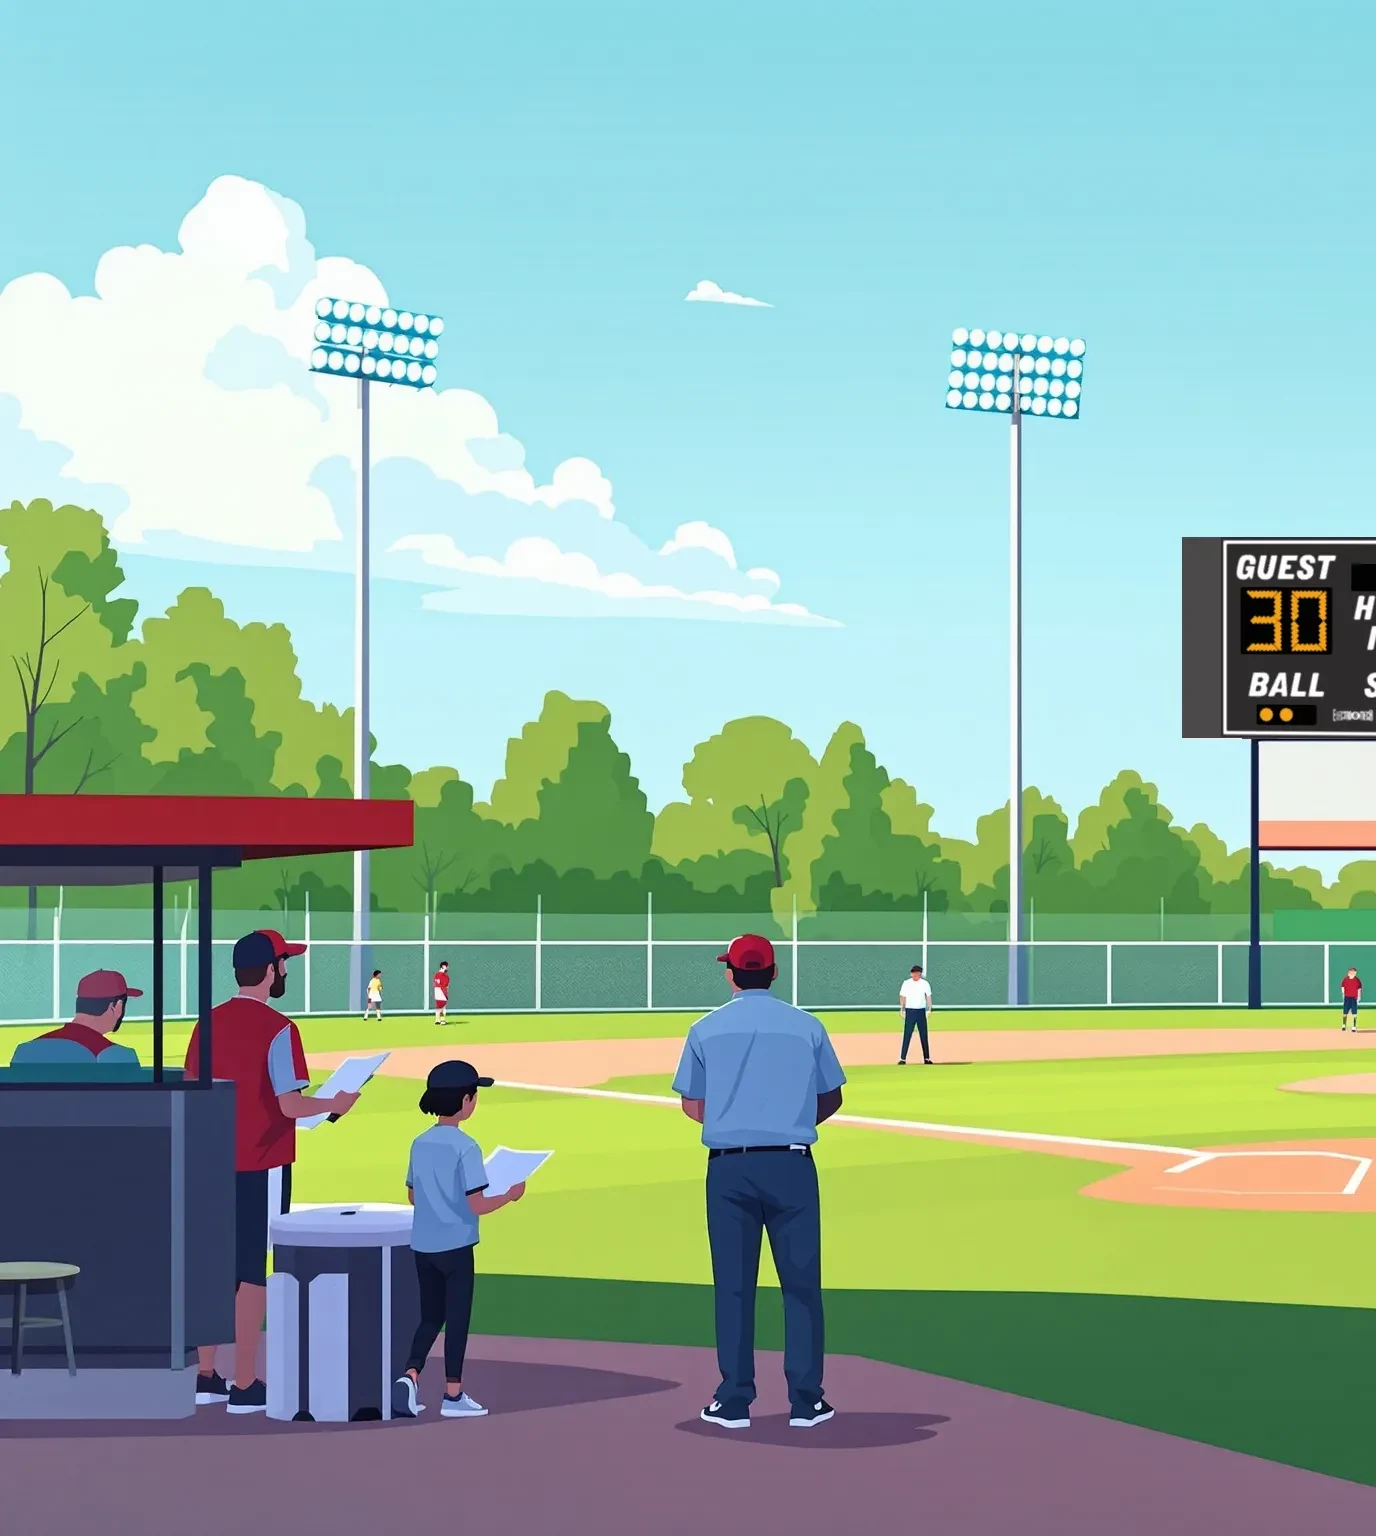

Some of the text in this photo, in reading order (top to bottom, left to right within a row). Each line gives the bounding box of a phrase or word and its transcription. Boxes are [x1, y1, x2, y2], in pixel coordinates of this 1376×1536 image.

[1237, 555, 1336, 580] GUEST
[1354, 596, 1375, 620] H
[1247, 591, 1326, 651] 30
[1249, 672, 1324, 697] BALL
